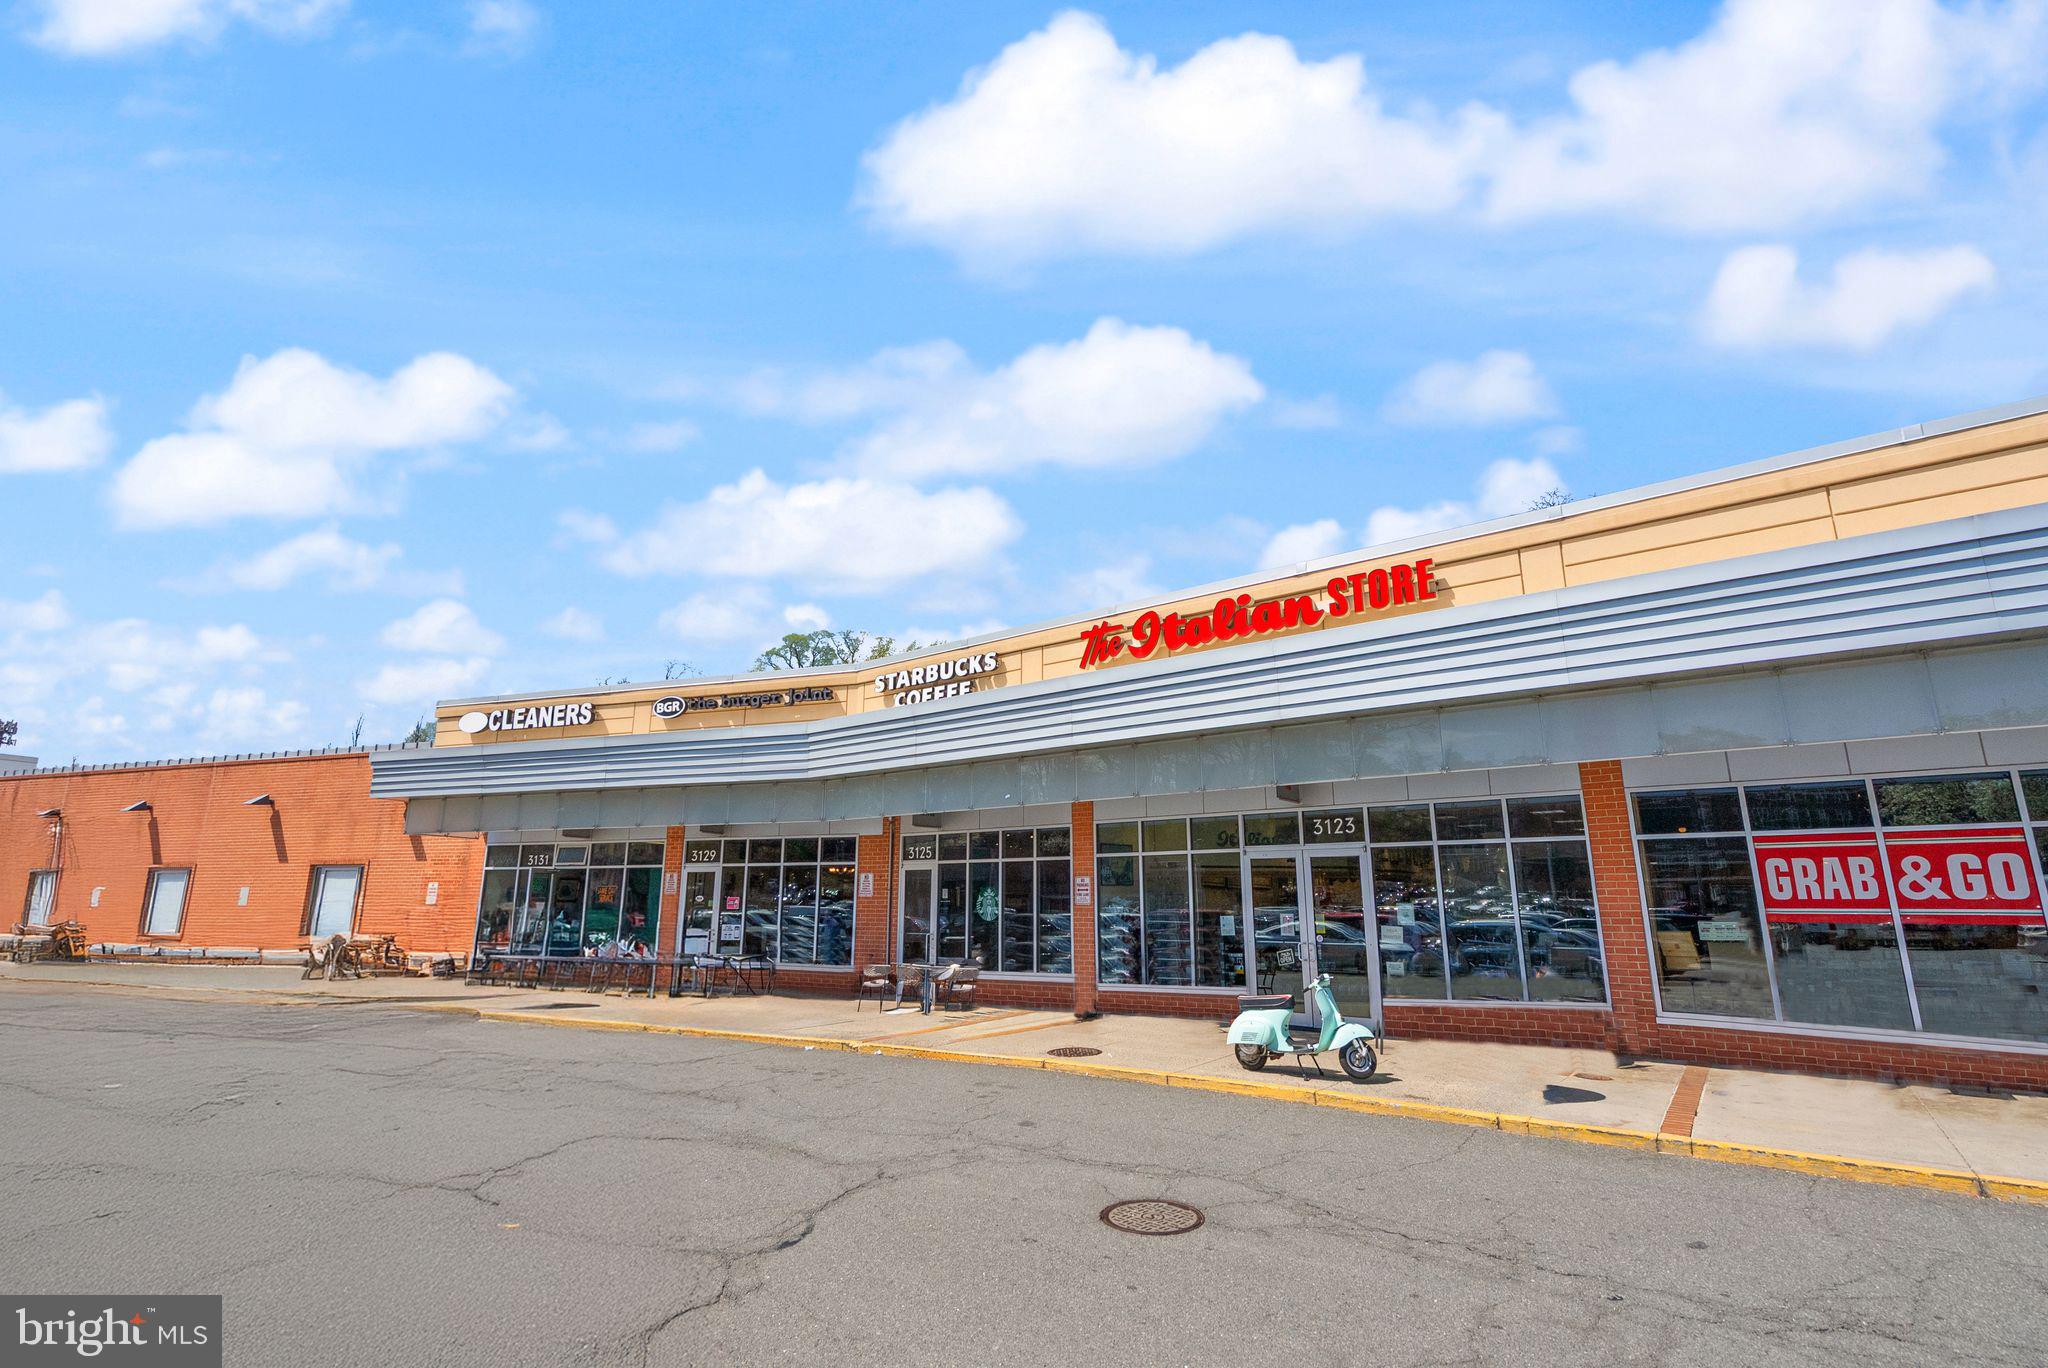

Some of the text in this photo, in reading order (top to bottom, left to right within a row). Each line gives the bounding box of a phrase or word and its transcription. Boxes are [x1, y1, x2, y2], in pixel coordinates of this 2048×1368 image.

[1079, 558, 1437, 670] The Italian STORE
[873, 651, 998, 693] STARBUCKS
[656, 701, 681, 714] BGR
[687, 696, 719, 711] the
[719, 694, 783, 709] burger
[487, 702, 594, 732] CLEANERS
[1312, 817, 1356, 835] 3123
[527, 854, 550, 866] 3131
[691, 850, 717, 862] 3129
[908, 846, 932, 860] 3125
[1764, 853, 2031, 900] GRAB & GO
